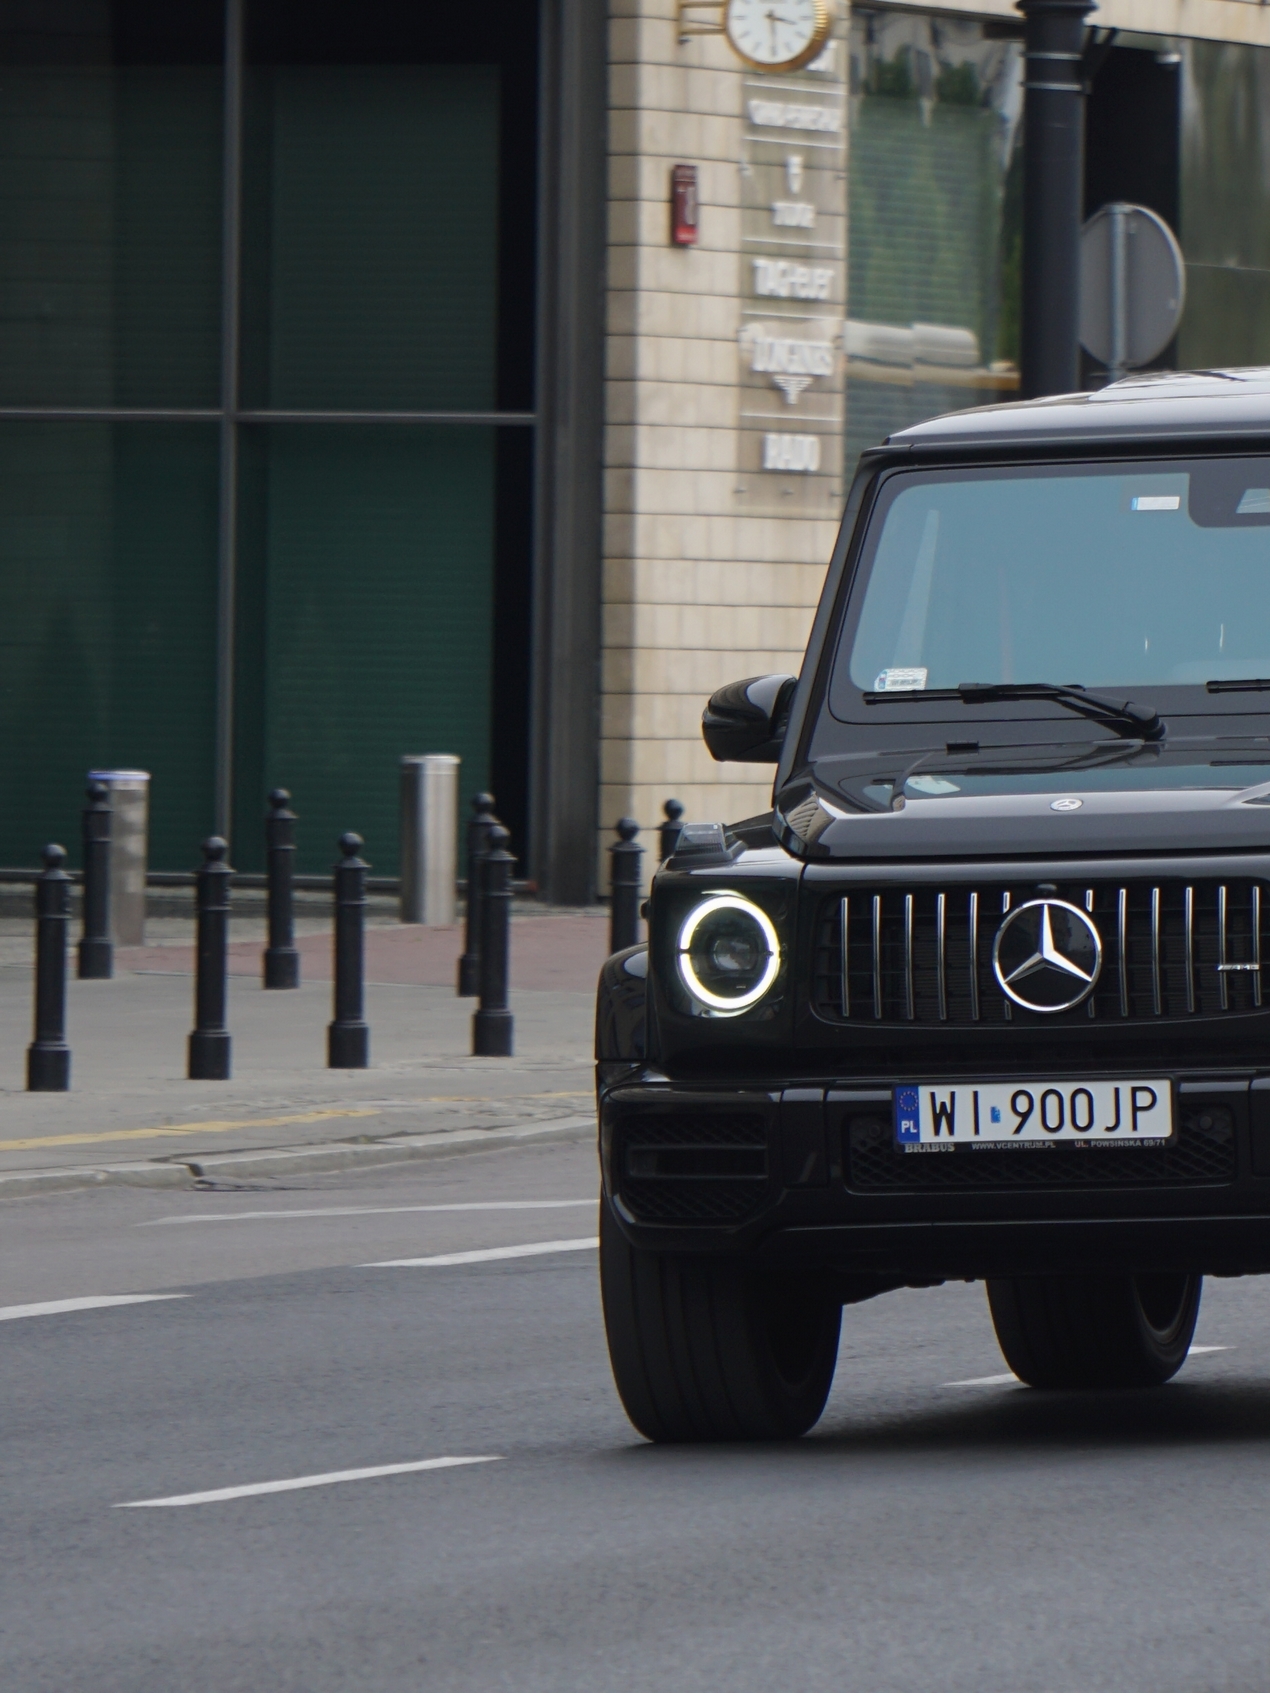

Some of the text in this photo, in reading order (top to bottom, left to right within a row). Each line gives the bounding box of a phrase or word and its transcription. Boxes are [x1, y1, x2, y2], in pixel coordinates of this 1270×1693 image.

[929, 1086, 1158, 1137] WI 900JP
[901, 1120, 918, 1134] PL
[904, 1142, 956, 1153] BRABUS
[971, 1141, 1056, 1150] WWW.VCENTRUM.PL
